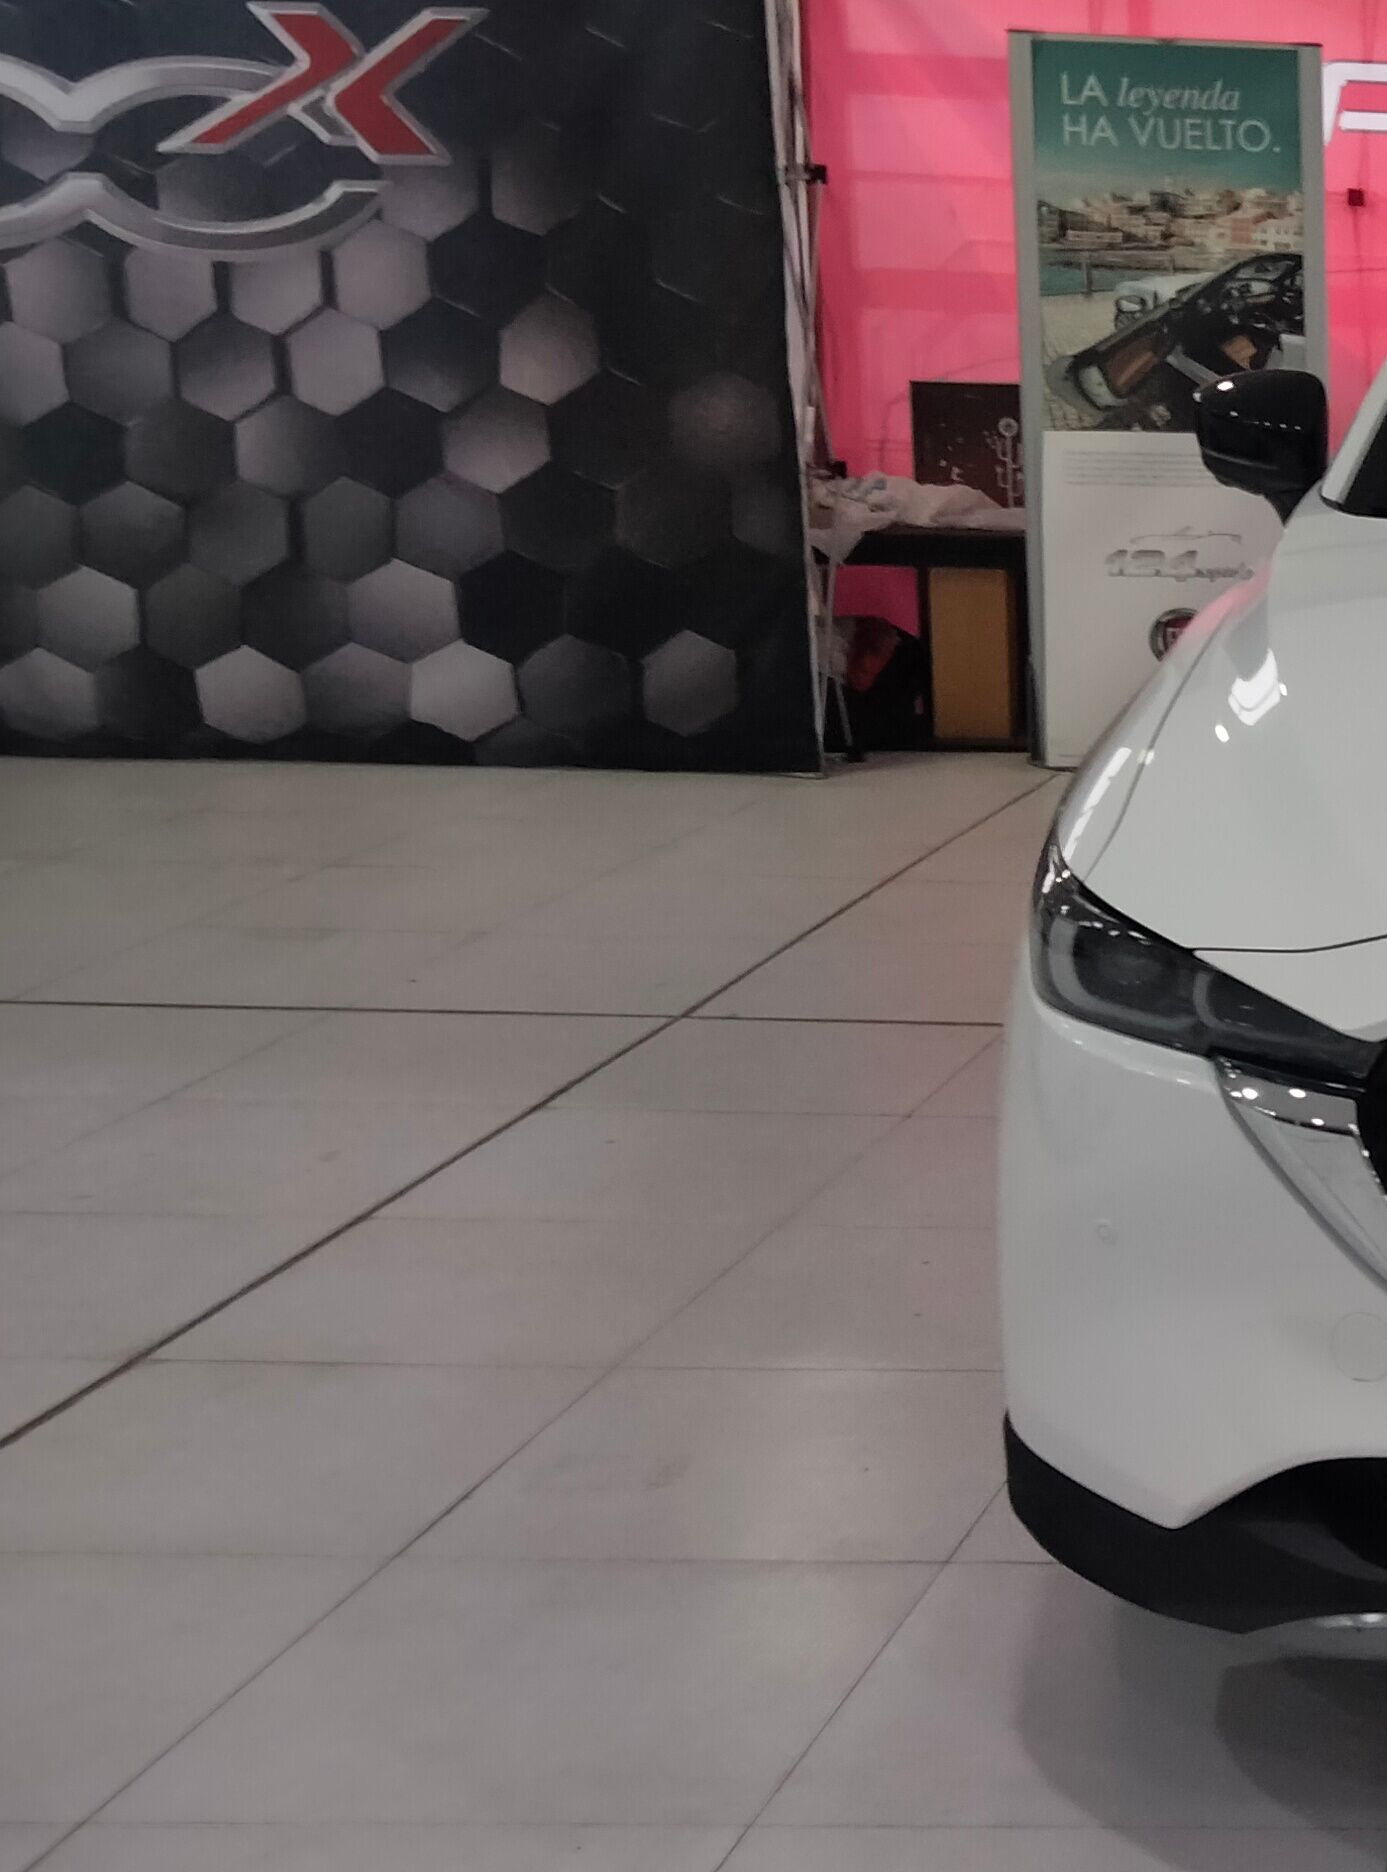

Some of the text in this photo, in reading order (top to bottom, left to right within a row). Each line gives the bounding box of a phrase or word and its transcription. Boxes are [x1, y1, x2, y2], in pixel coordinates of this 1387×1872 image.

[1060, 71, 1240, 116] LA leyenda
[1062, 113, 1281, 153] HA VUELTO.
